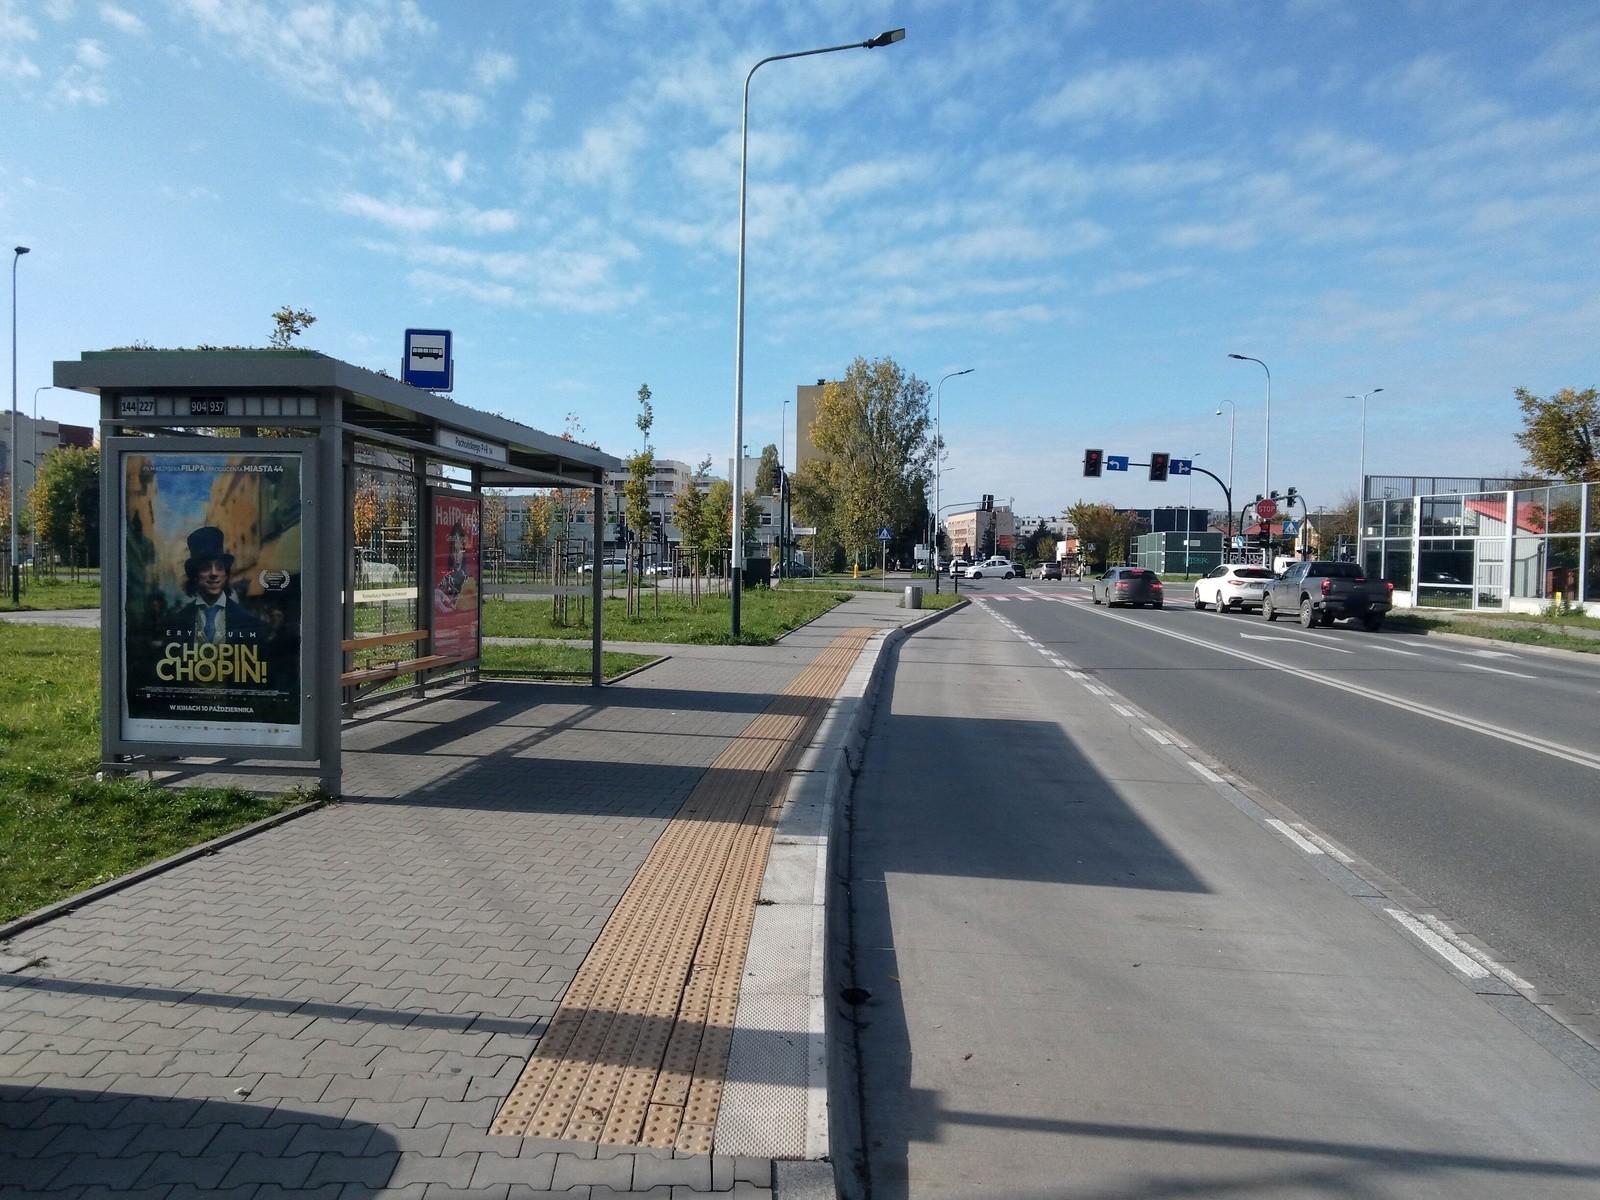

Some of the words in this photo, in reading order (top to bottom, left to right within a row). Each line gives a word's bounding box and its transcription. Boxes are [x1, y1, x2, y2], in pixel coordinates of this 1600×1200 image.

[122, 401, 137, 412] 144
[140, 401, 154, 412] 227
[191, 401, 207, 412] 904
[209, 401, 225, 412] 937
[181, 464, 205, 473] FILIPA
[243, 464, 273, 473] MIASTA
[274, 465, 284, 473] 44
[1258, 505, 1276, 513] STOP
[166, 629, 202, 637] ERYK
[165, 642, 258, 662] CHOPIN
[156, 658, 268, 684] CHOPIN!
[177, 704, 201, 712] KINACH
[208, 704, 254, 713] PAŹDZIERNIKA
